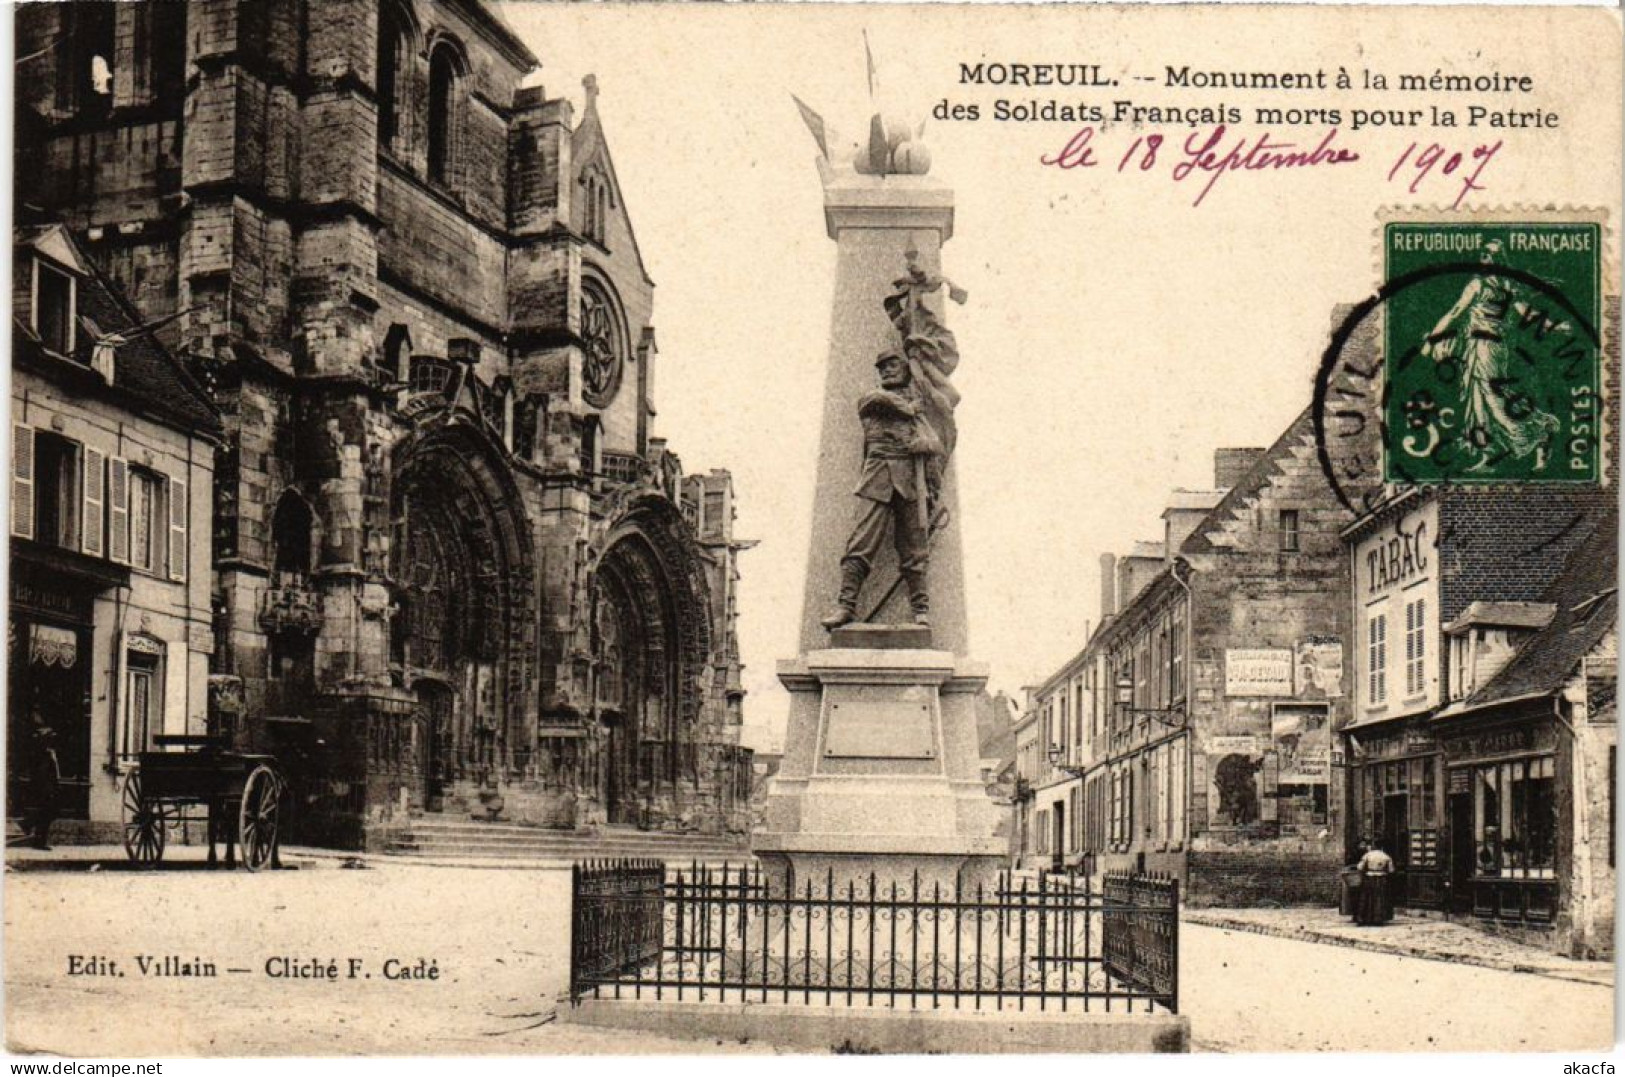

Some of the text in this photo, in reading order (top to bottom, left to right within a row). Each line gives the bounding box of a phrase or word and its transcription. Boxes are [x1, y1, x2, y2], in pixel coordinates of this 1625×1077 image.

[1041, 124, 1503, 212] le 18 Septembre 1907
[1509, 232, 1591, 253] FRANÇAISE
[1571, 385, 1590, 470] POSTES
[1367, 520, 1428, 594] TABAC
